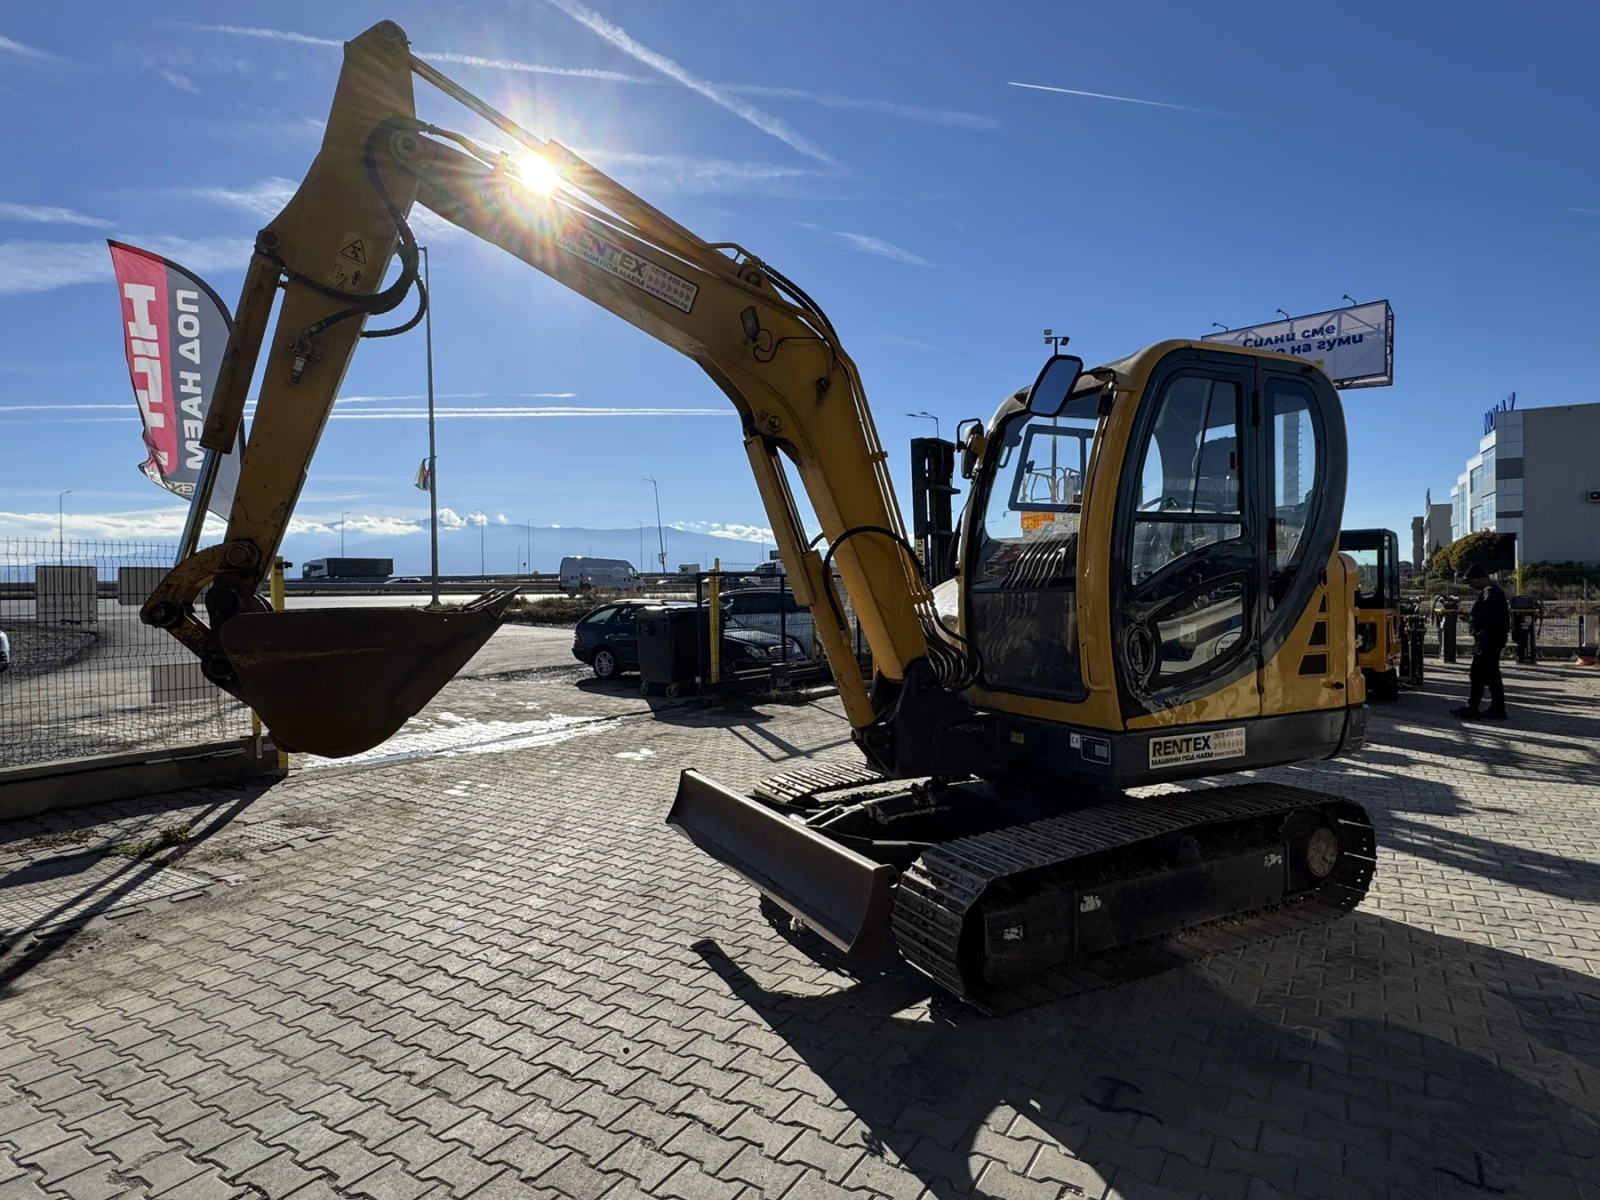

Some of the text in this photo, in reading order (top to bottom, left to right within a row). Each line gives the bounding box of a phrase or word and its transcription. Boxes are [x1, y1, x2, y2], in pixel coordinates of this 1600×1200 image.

[563, 227, 647, 277] ENTEX
[600, 260, 618, 273] ПОД
[618, 269, 645, 287] НАЕМ
[668, 275, 681, 286] 450
[681, 283, 694, 293] 400
[1301, 324, 1336, 339] сме
[1291, 343, 1312, 355] на
[1317, 334, 1363, 352] гуми
[1152, 735, 1211, 757] RENTEX
[1151, 751, 1214, 766] МАШИНИ ПОД НАЕМ
